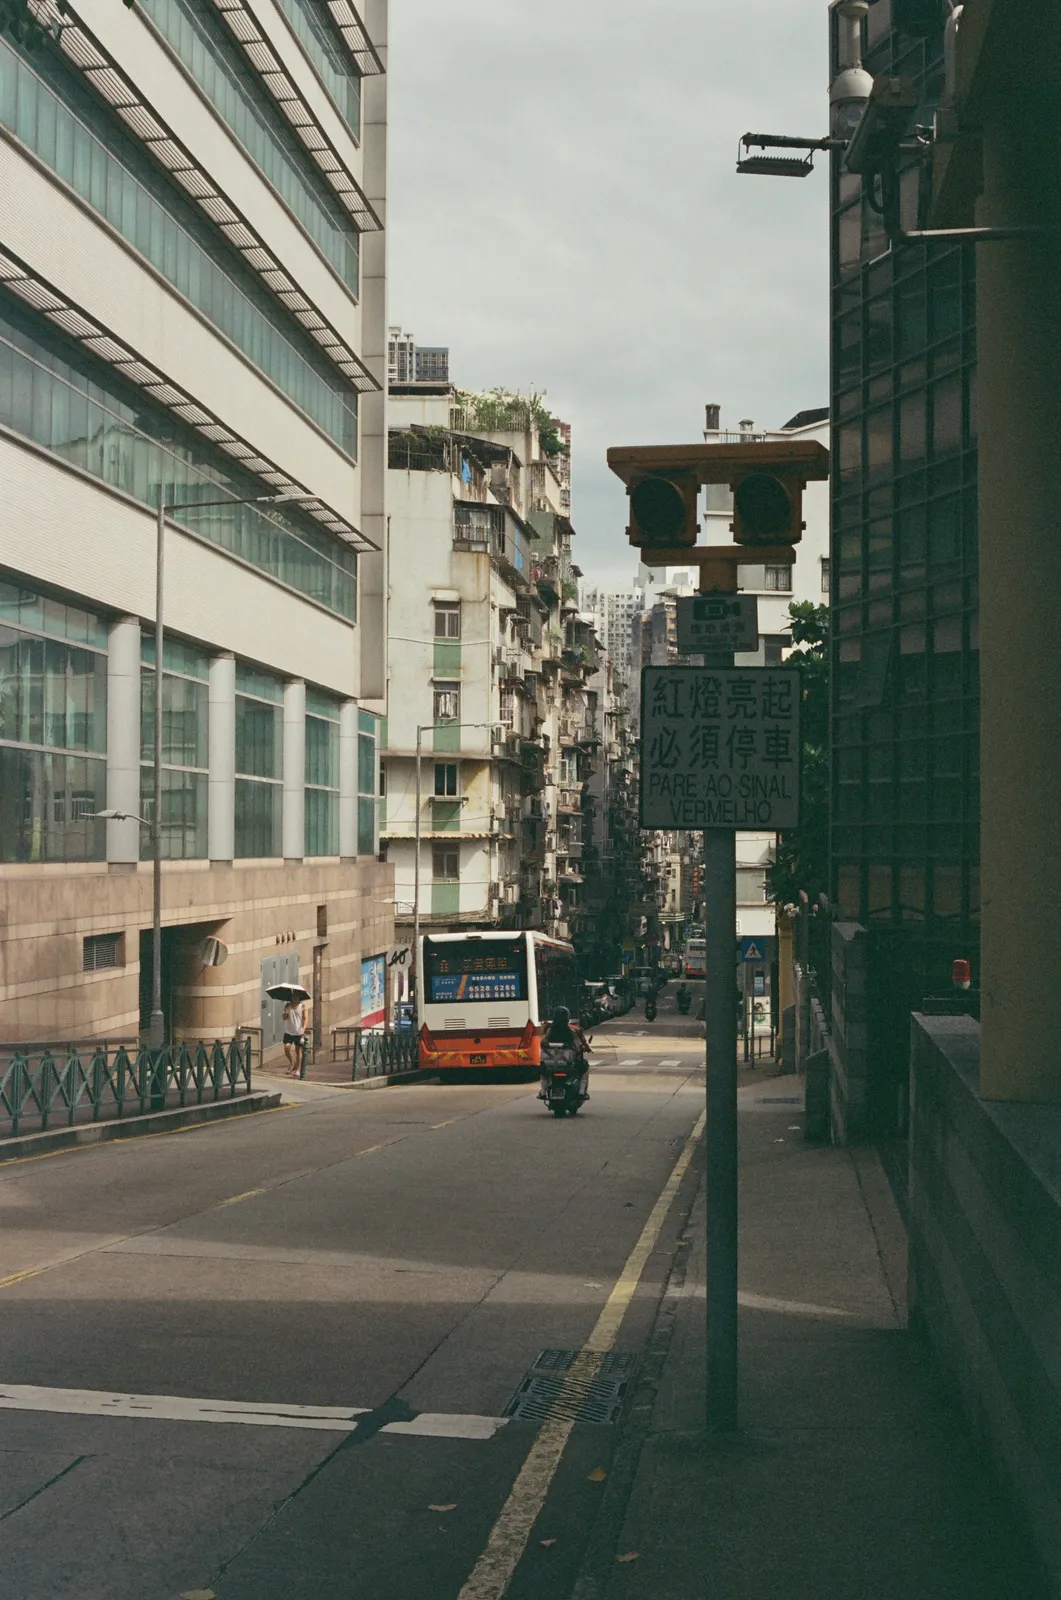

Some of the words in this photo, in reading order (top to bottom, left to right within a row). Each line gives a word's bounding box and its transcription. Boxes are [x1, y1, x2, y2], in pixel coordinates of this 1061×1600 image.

[652, 676, 792, 720] 紅燈亮起
[650, 724, 792, 770] 必須停車
[650, 773, 697, 797] PARE
[705, 773, 731, 797] AO
[739, 773, 792, 799] SINAL
[670, 800, 771, 824] VERMELHO
[494, 984, 516, 992] 6286
